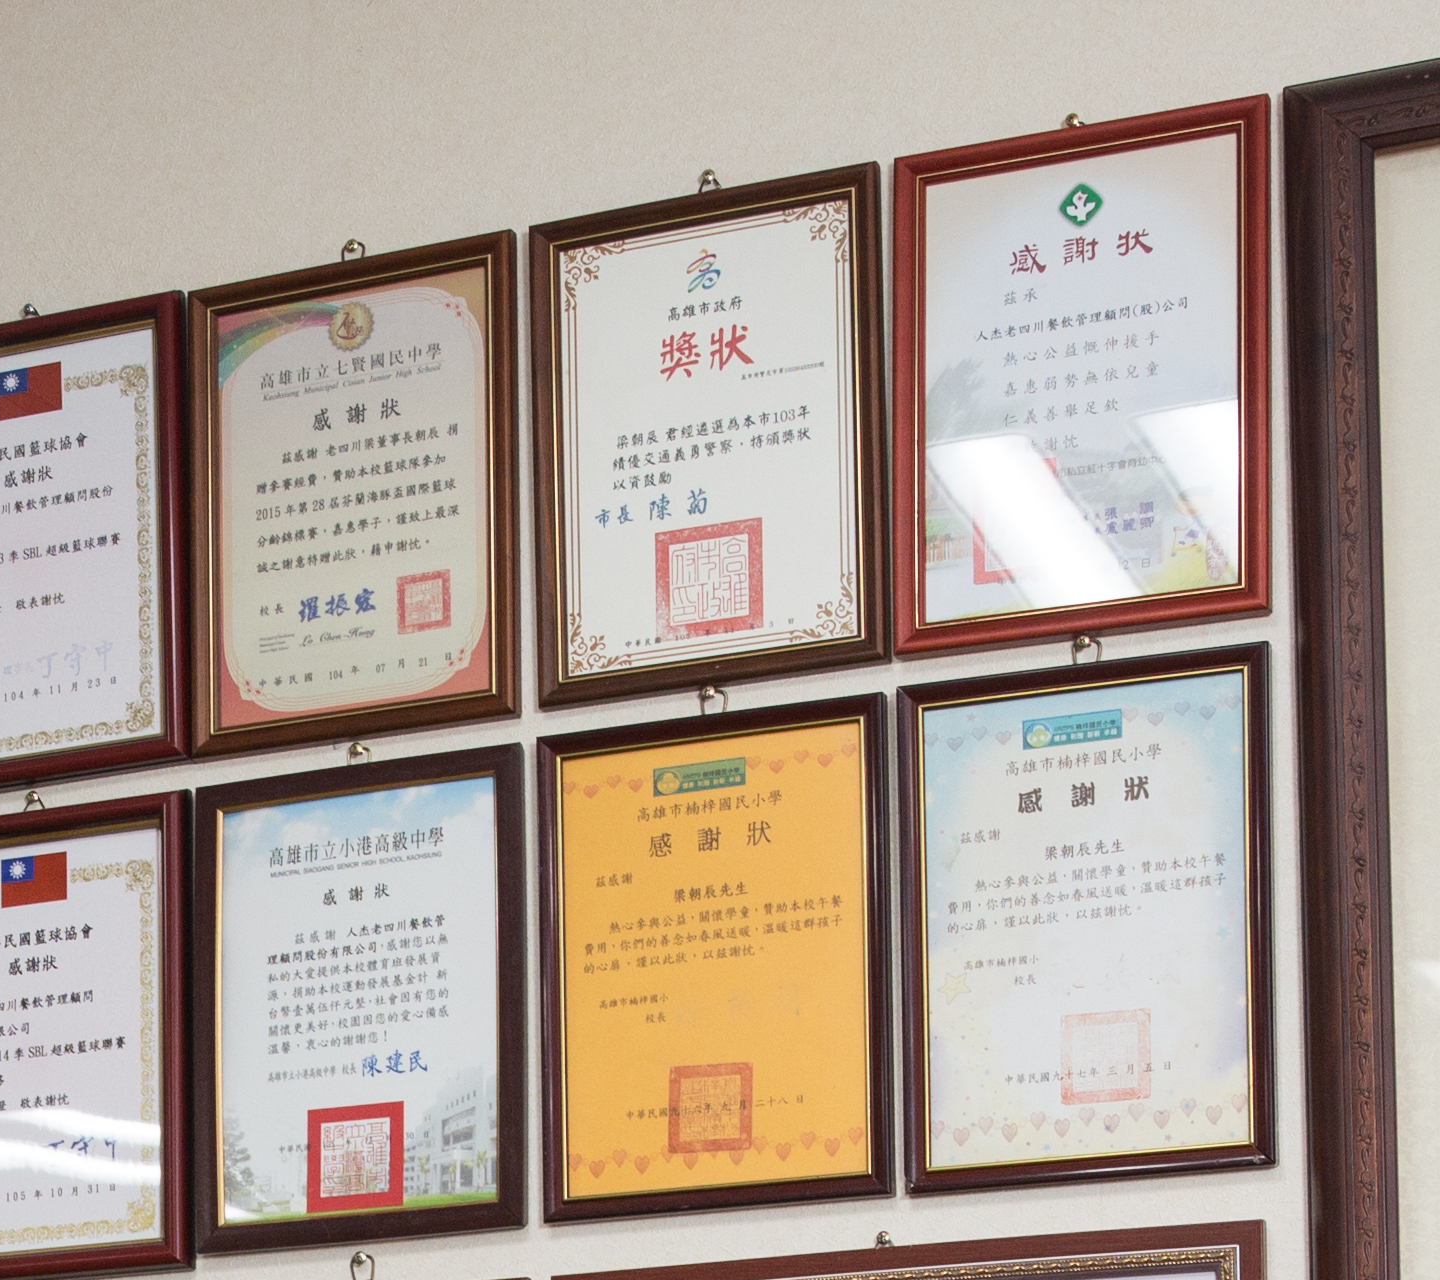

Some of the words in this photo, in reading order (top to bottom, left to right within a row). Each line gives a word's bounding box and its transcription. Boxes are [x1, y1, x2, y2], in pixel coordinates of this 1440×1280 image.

[1009, 229, 1153, 275] 感謝狀
[668, 296, 742, 322] 高雄市政府
[660, 324, 754, 382] 獎狀
[1003, 330, 1159, 368] 熱心公益慨伸援手
[259, 342, 442, 390] 高雄市立七賢國民中學
[395, 368, 413, 379] High
[417, 363, 442, 375] School
[1004, 361, 1160, 398] 嘉惠弱勢無依兒童
[312, 398, 401, 431] 感謝狀
[326, 429, 440, 457] 老四川梁董事長朝辰
[617, 429, 659, 449] 梁朝辰
[4, 466, 53, 488] 感謝狀
[612, 471, 672, 491] 以資鼓勵
[16, 592, 65, 611] 敬表謝忱
[1005, 743, 1162, 777] 高雄市楠梓國民小學
[637, 789, 782, 823] 高雄市楠梓國民小學
[1018, 776, 1150, 814] 感謝狀
[270, 826, 444, 868] 高雄市立小港高級中學
[649, 820, 772, 858] 感謝狀
[960, 828, 1001, 845] 茲感謝
[1044, 839, 1125, 862] 梁朝辰先生
[337, 861, 359, 870] SENIOR
[362, 859, 377, 867] HIGH
[322, 883, 390, 906] 感謝狀
[674, 882, 748, 903] 梁朝辰先生
[346, 914, 446, 939] 人杰老四川餐飲管
[8, 955, 58, 976] 感謝狀
[268, 951, 440, 983] 私的大愛提供本校體育班發展資
[963, 955, 1039, 971] 高雄市楠梓國小
[1013, 973, 1037, 986] 校長
[599, 993, 669, 1009] 高雄市楠梓國小
[645, 1011, 666, 1024] 校長
[268, 1065, 336, 1083] 高雄市立小港高級中學
[20, 1093, 70, 1109] 敬表謝忱
